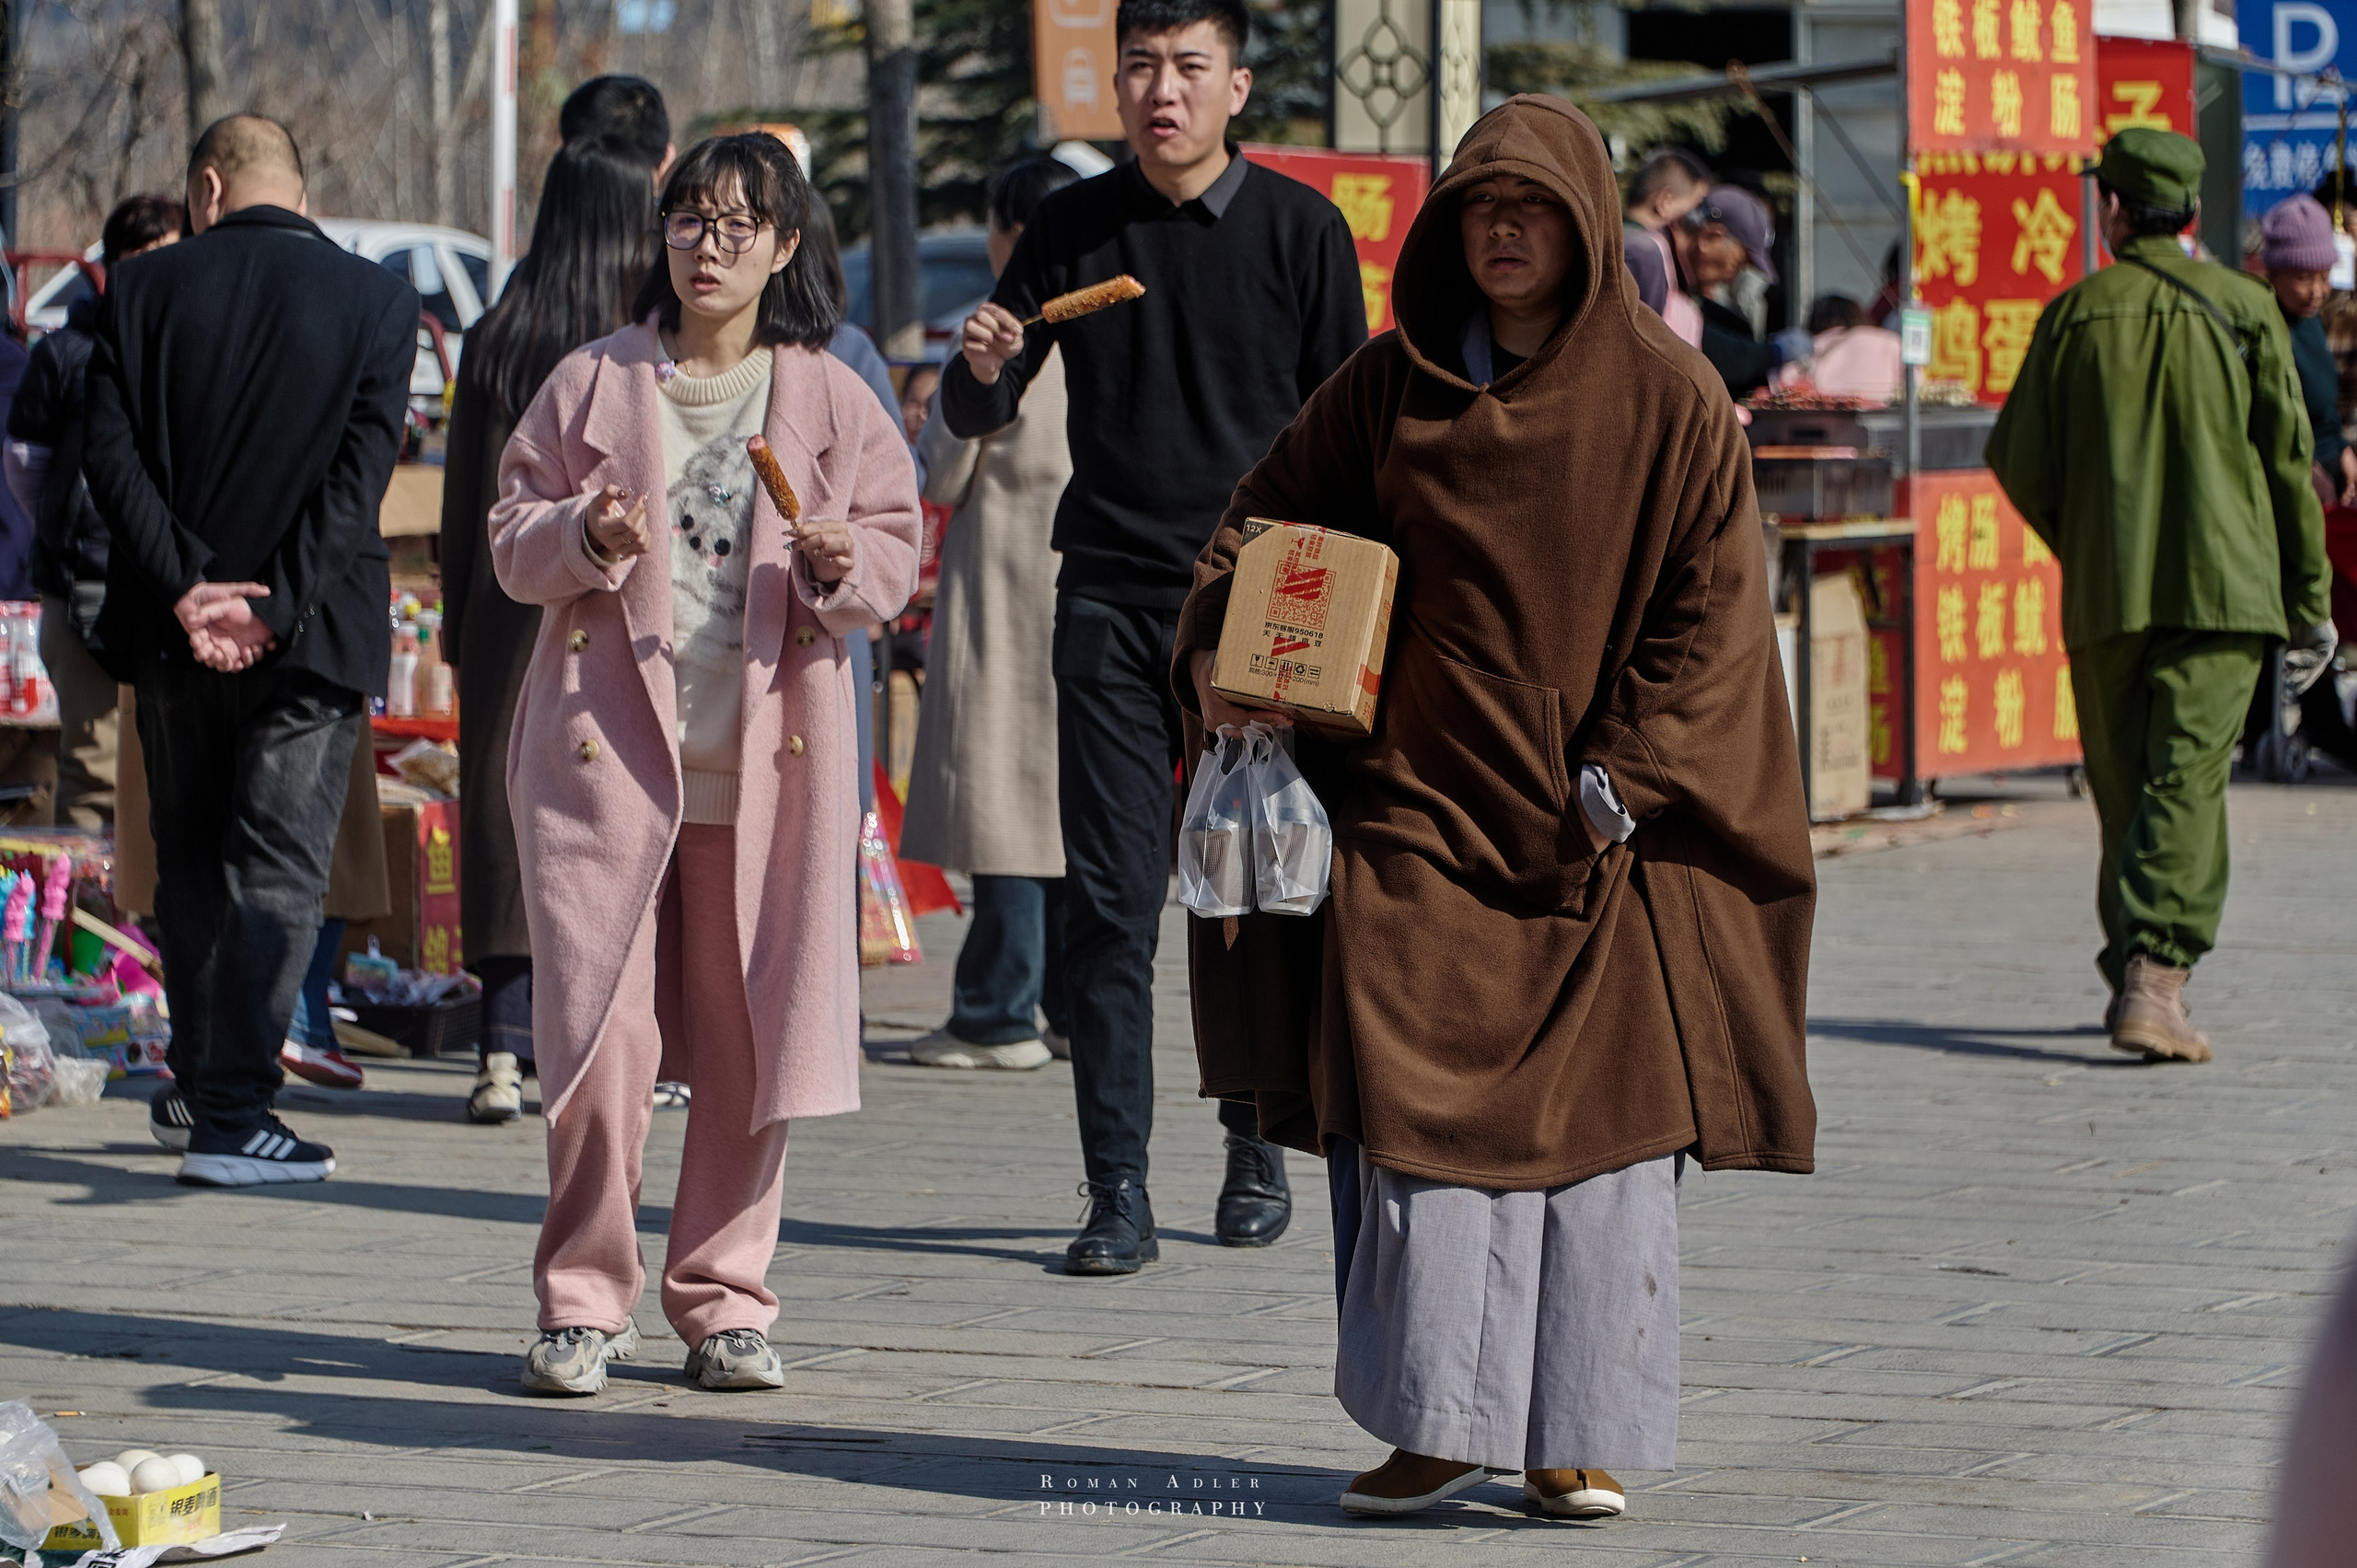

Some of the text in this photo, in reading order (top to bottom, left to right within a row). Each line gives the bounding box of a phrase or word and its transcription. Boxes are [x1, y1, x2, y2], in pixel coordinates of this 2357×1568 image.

[2272, 2, 2340, 110] P
[1246, 524, 1262, 534] 12X
[1264, 621, 1324, 639] 京东客服950618
